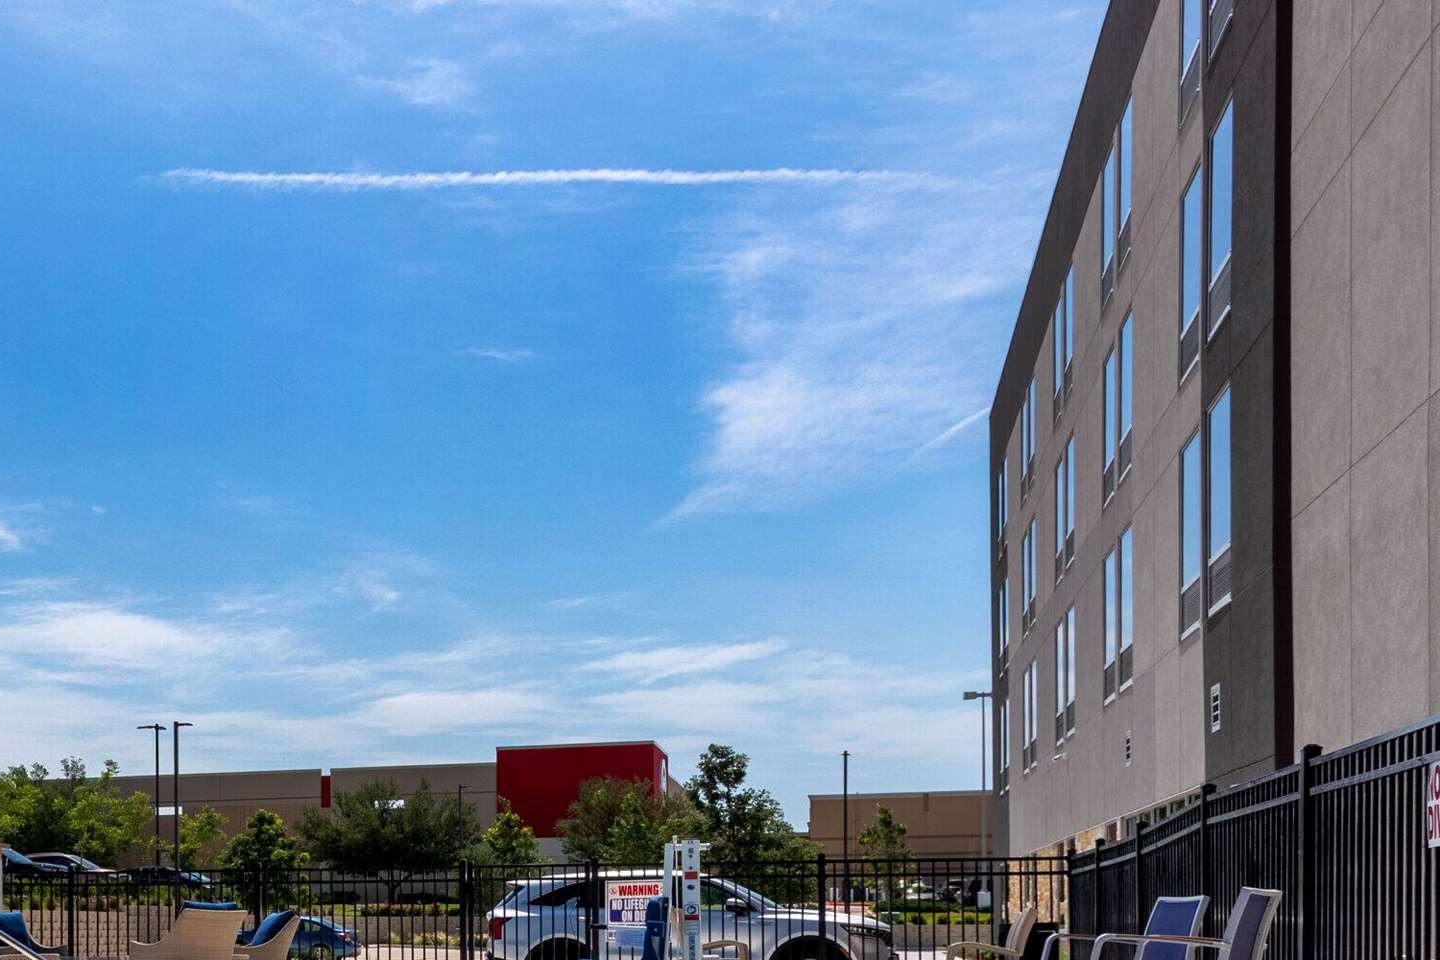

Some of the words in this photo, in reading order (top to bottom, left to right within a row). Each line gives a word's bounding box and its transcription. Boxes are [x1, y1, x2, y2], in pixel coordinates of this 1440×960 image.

[618, 884, 659, 896] WARNING
[611, 899, 623, 911] NO
[622, 910, 633, 922] ON
[634, 910, 646, 922] DU
